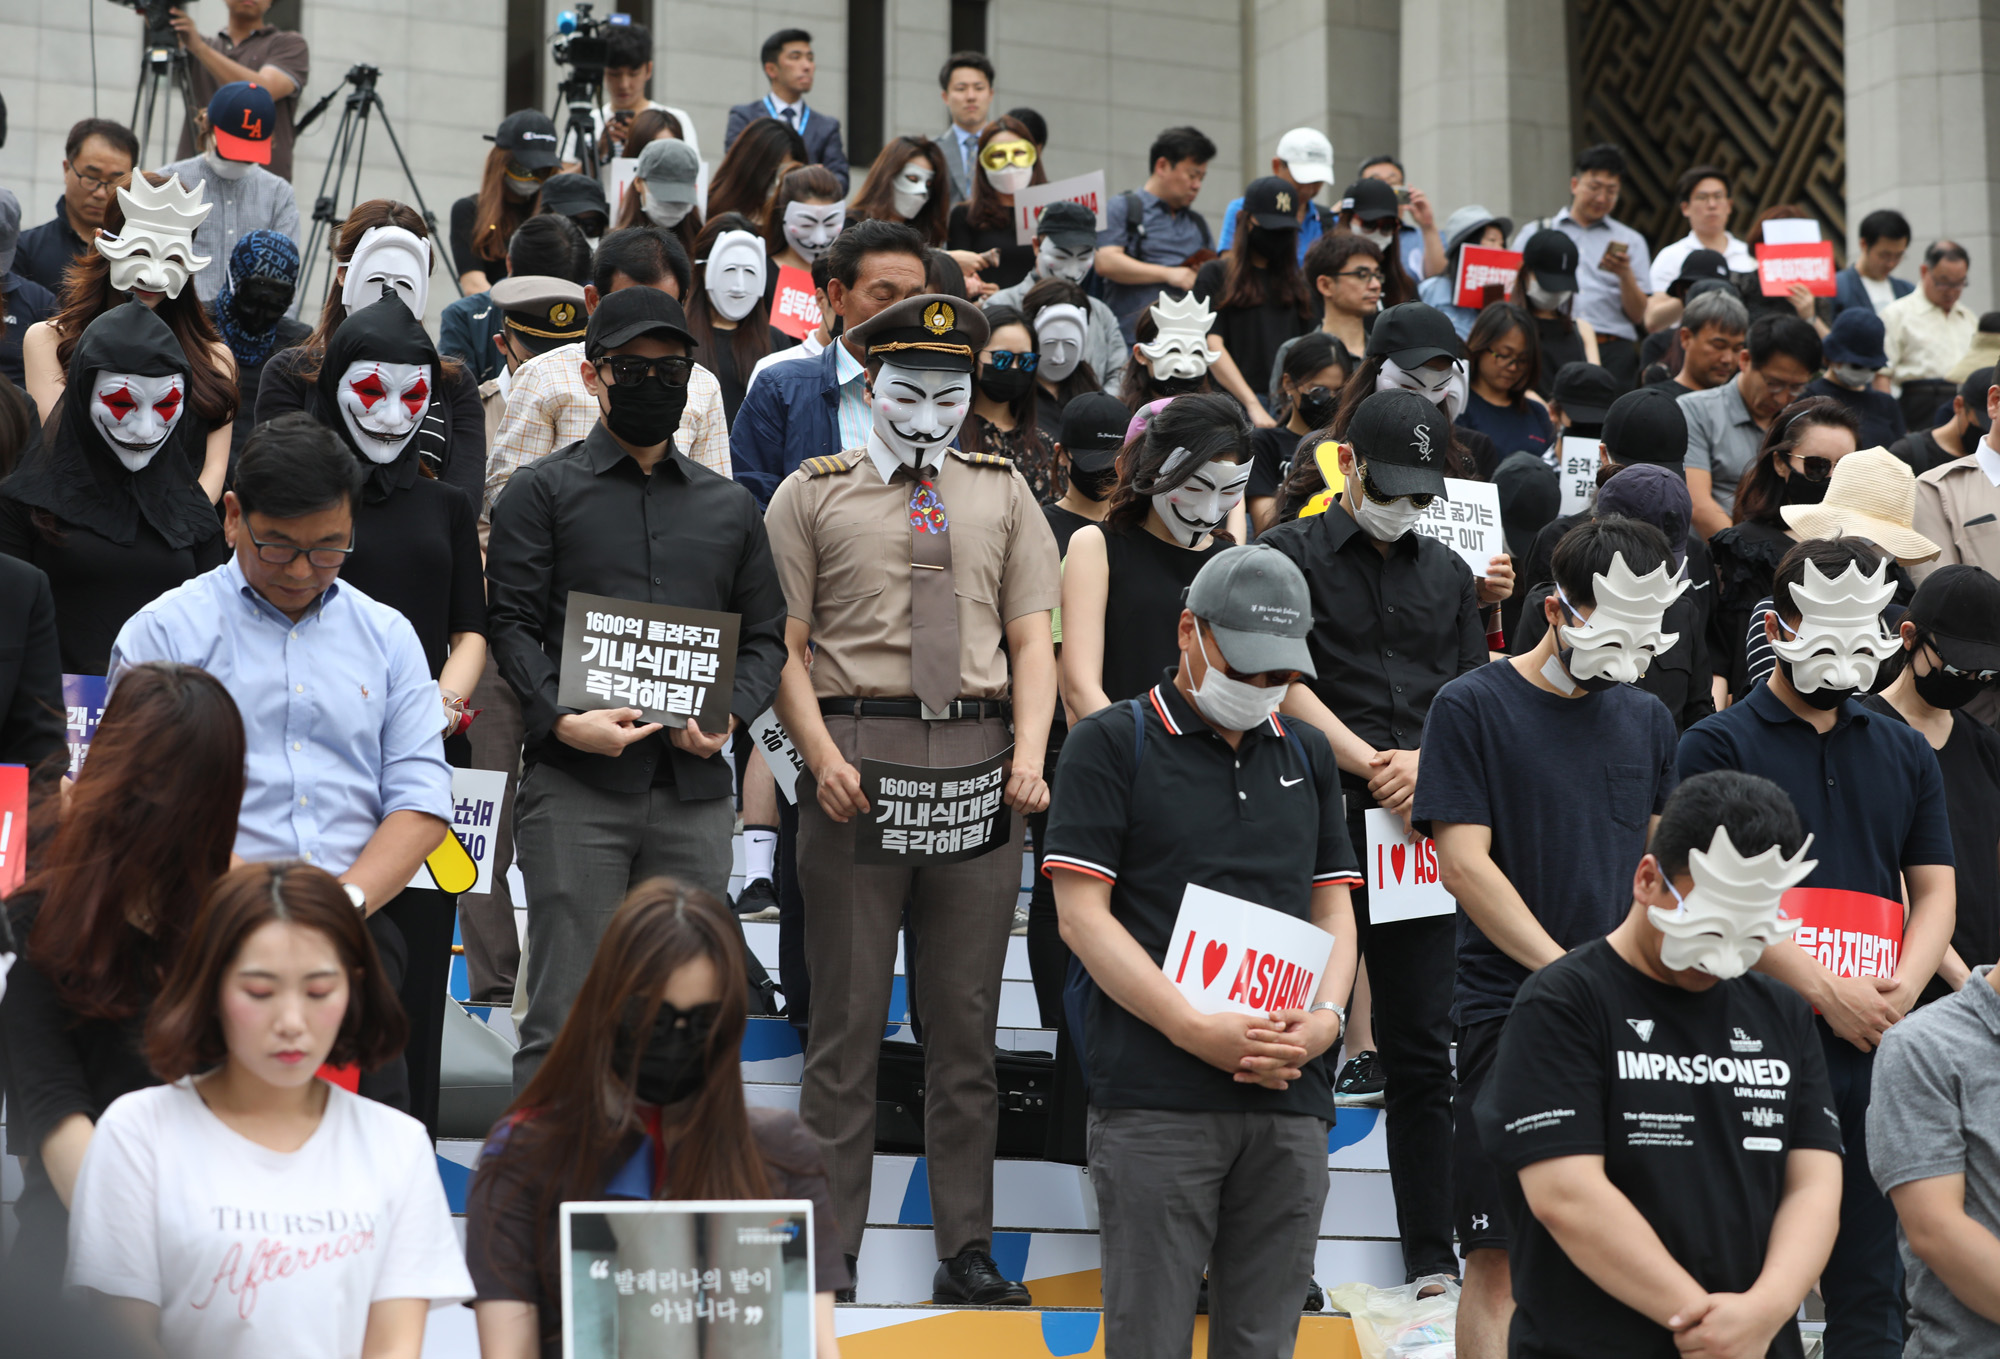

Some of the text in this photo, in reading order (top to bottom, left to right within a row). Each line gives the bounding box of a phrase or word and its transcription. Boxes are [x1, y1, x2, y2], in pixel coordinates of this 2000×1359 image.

[1449, 500, 1494, 527] 굶기는
[1458, 528, 1485, 551] OUT
[586, 611, 721, 649] 1600억 돌려주고
[581, 636, 720, 683] 기내식대란
[586, 669, 707, 716] 즉각해결!
[879, 766, 1003, 798] 1600억 돌려주고
[876, 786, 1003, 827] 기내식대란
[882, 817, 994, 855] 즉각해결!
[1378, 843, 1384, 890] I
[1175, 930, 1314, 1013] I ASIANA
[1617, 1050, 1791, 1087] IMPASSIONED
[1733, 1086, 1787, 1101] LIVE AGILITY
[210, 1206, 375, 1235] THURSDAY
[190, 1230, 375, 1320] Afternoon
[729, 1266, 771, 1293] 발이
